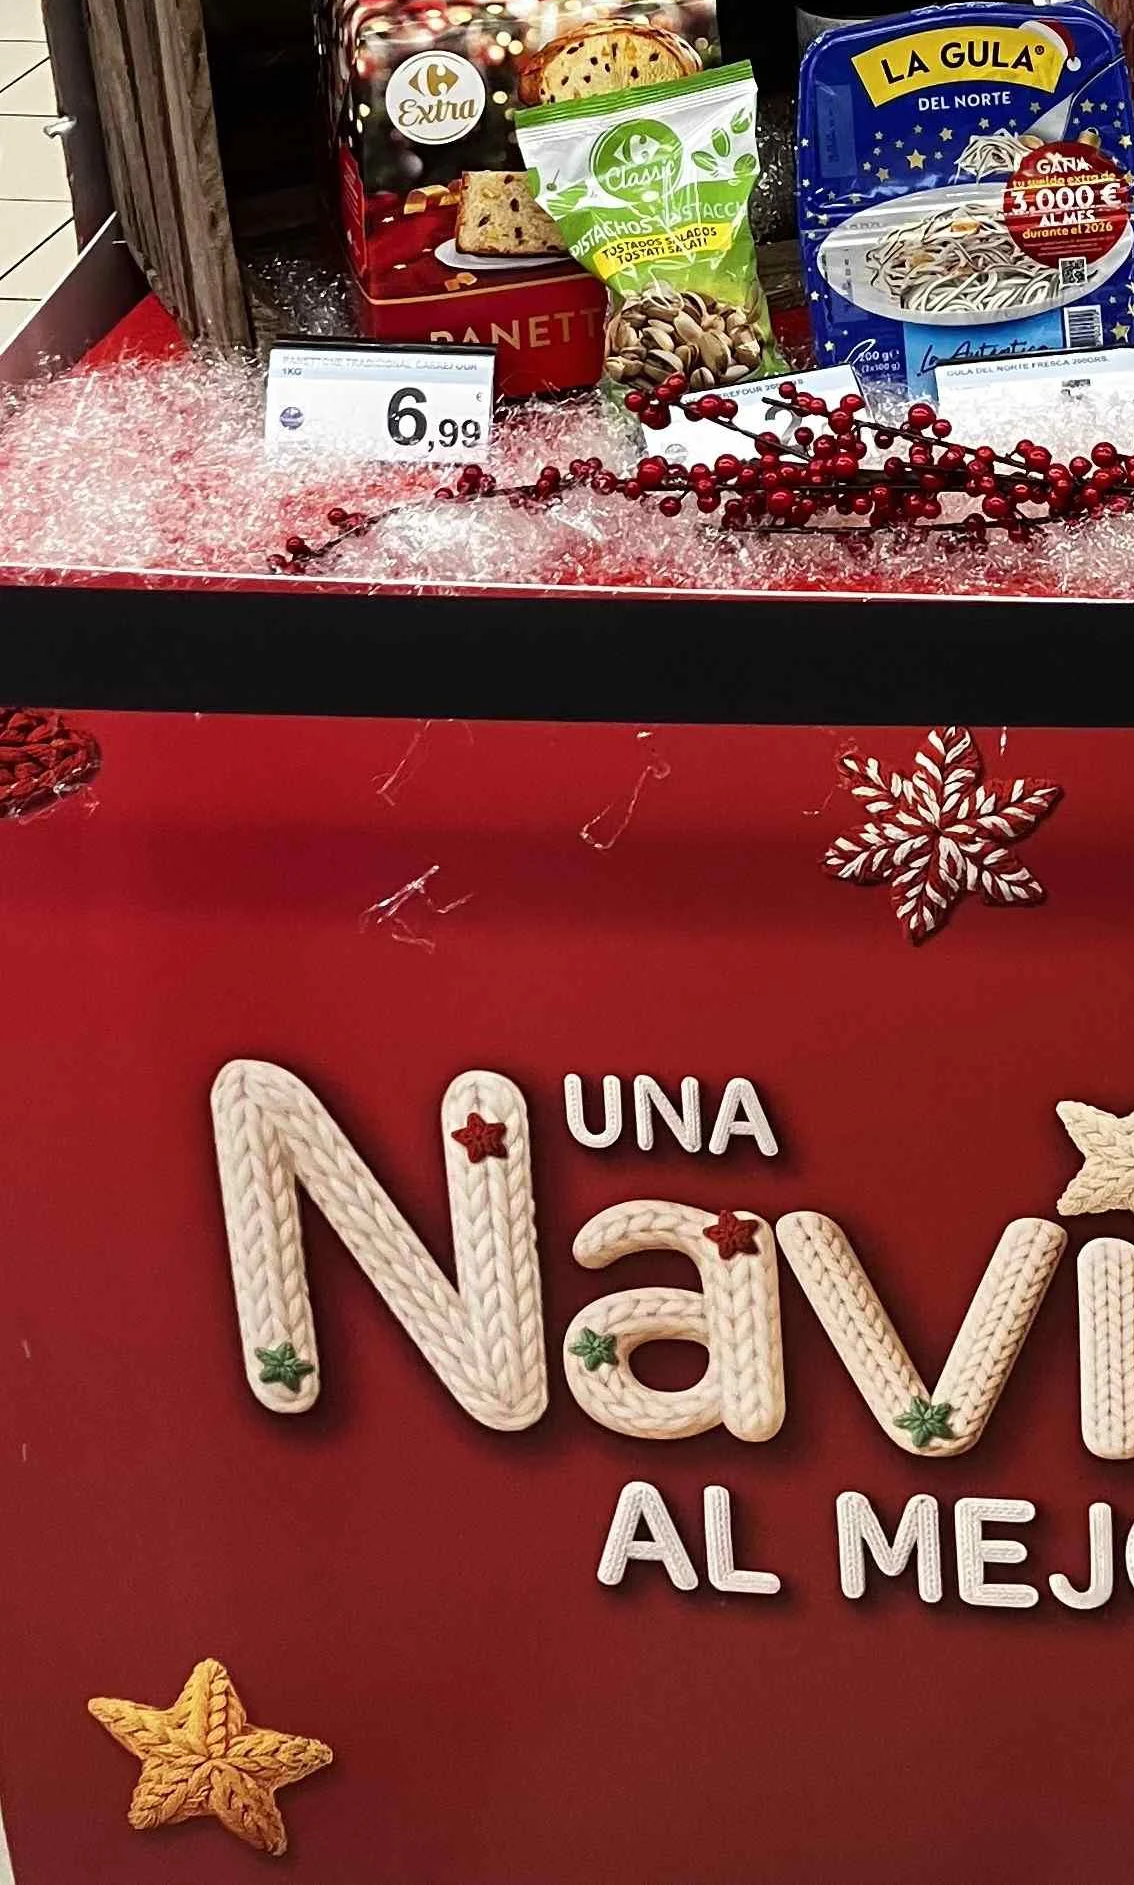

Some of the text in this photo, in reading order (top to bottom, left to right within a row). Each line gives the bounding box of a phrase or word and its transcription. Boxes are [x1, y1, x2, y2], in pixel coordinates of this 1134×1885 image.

[880, 40, 1035, 85] LA GULA
[397, 96, 480, 129] Extra
[918, 91, 1012, 112] DEL NORTE
[1066, 173, 1099, 186] extra
[1010, 184, 1095, 214] 3.000
[1022, 221, 1114, 240] durante el 2026
[1039, 209, 1097, 227] AL MES
[568, 218, 654, 259] PISTACHOS
[602, 237, 663, 259] TOSTADOS
[616, 248, 665, 264] TOSTATI
[387, 386, 482, 453] 6,99
[562, 1073, 778, 1156] UNA
[595, 1480, 781, 1597] AL
